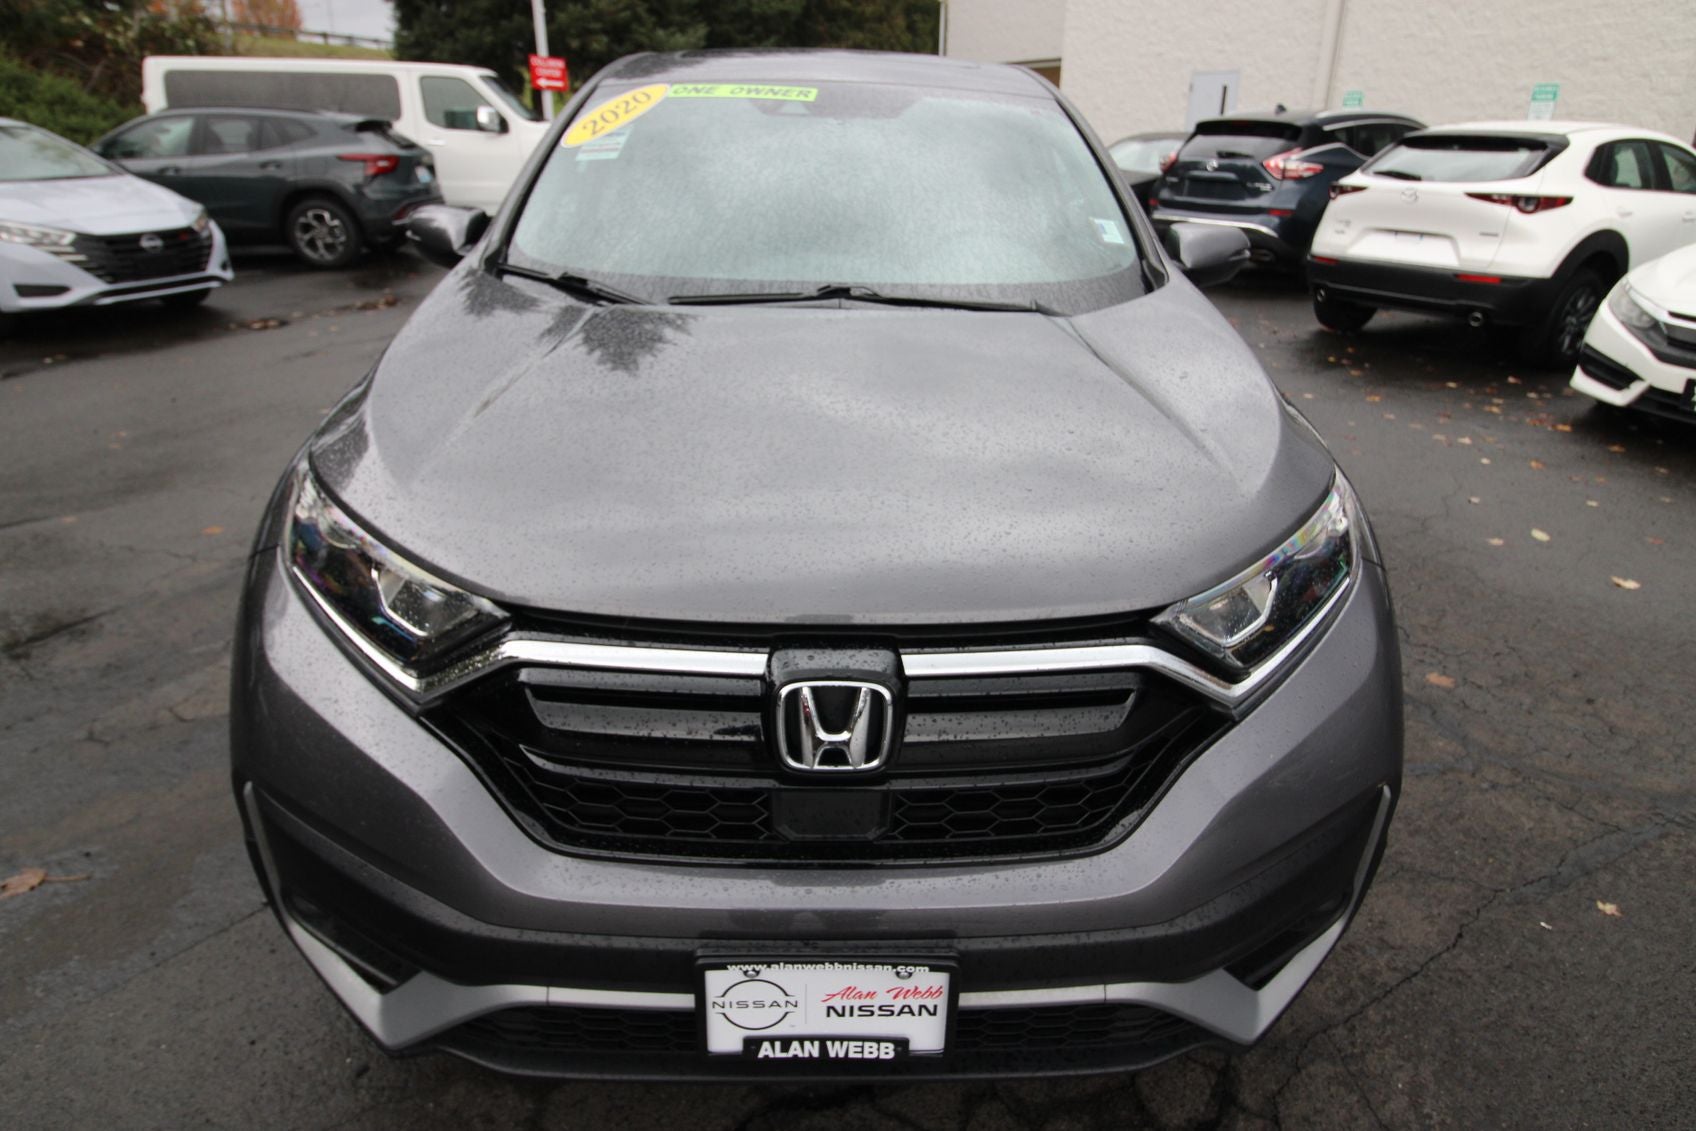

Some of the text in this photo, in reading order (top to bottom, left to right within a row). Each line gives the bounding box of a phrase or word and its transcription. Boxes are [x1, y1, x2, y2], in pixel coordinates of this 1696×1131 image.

[672, 86, 813, 99] ONE OWNER
[582, 91, 652, 136] 2020
[821, 984, 944, 1002] Alan Webb
[711, 999, 798, 1010] NISSAN
[825, 1003, 938, 1018] NISSAN
[757, 1041, 896, 1060] ALAN WEBB
